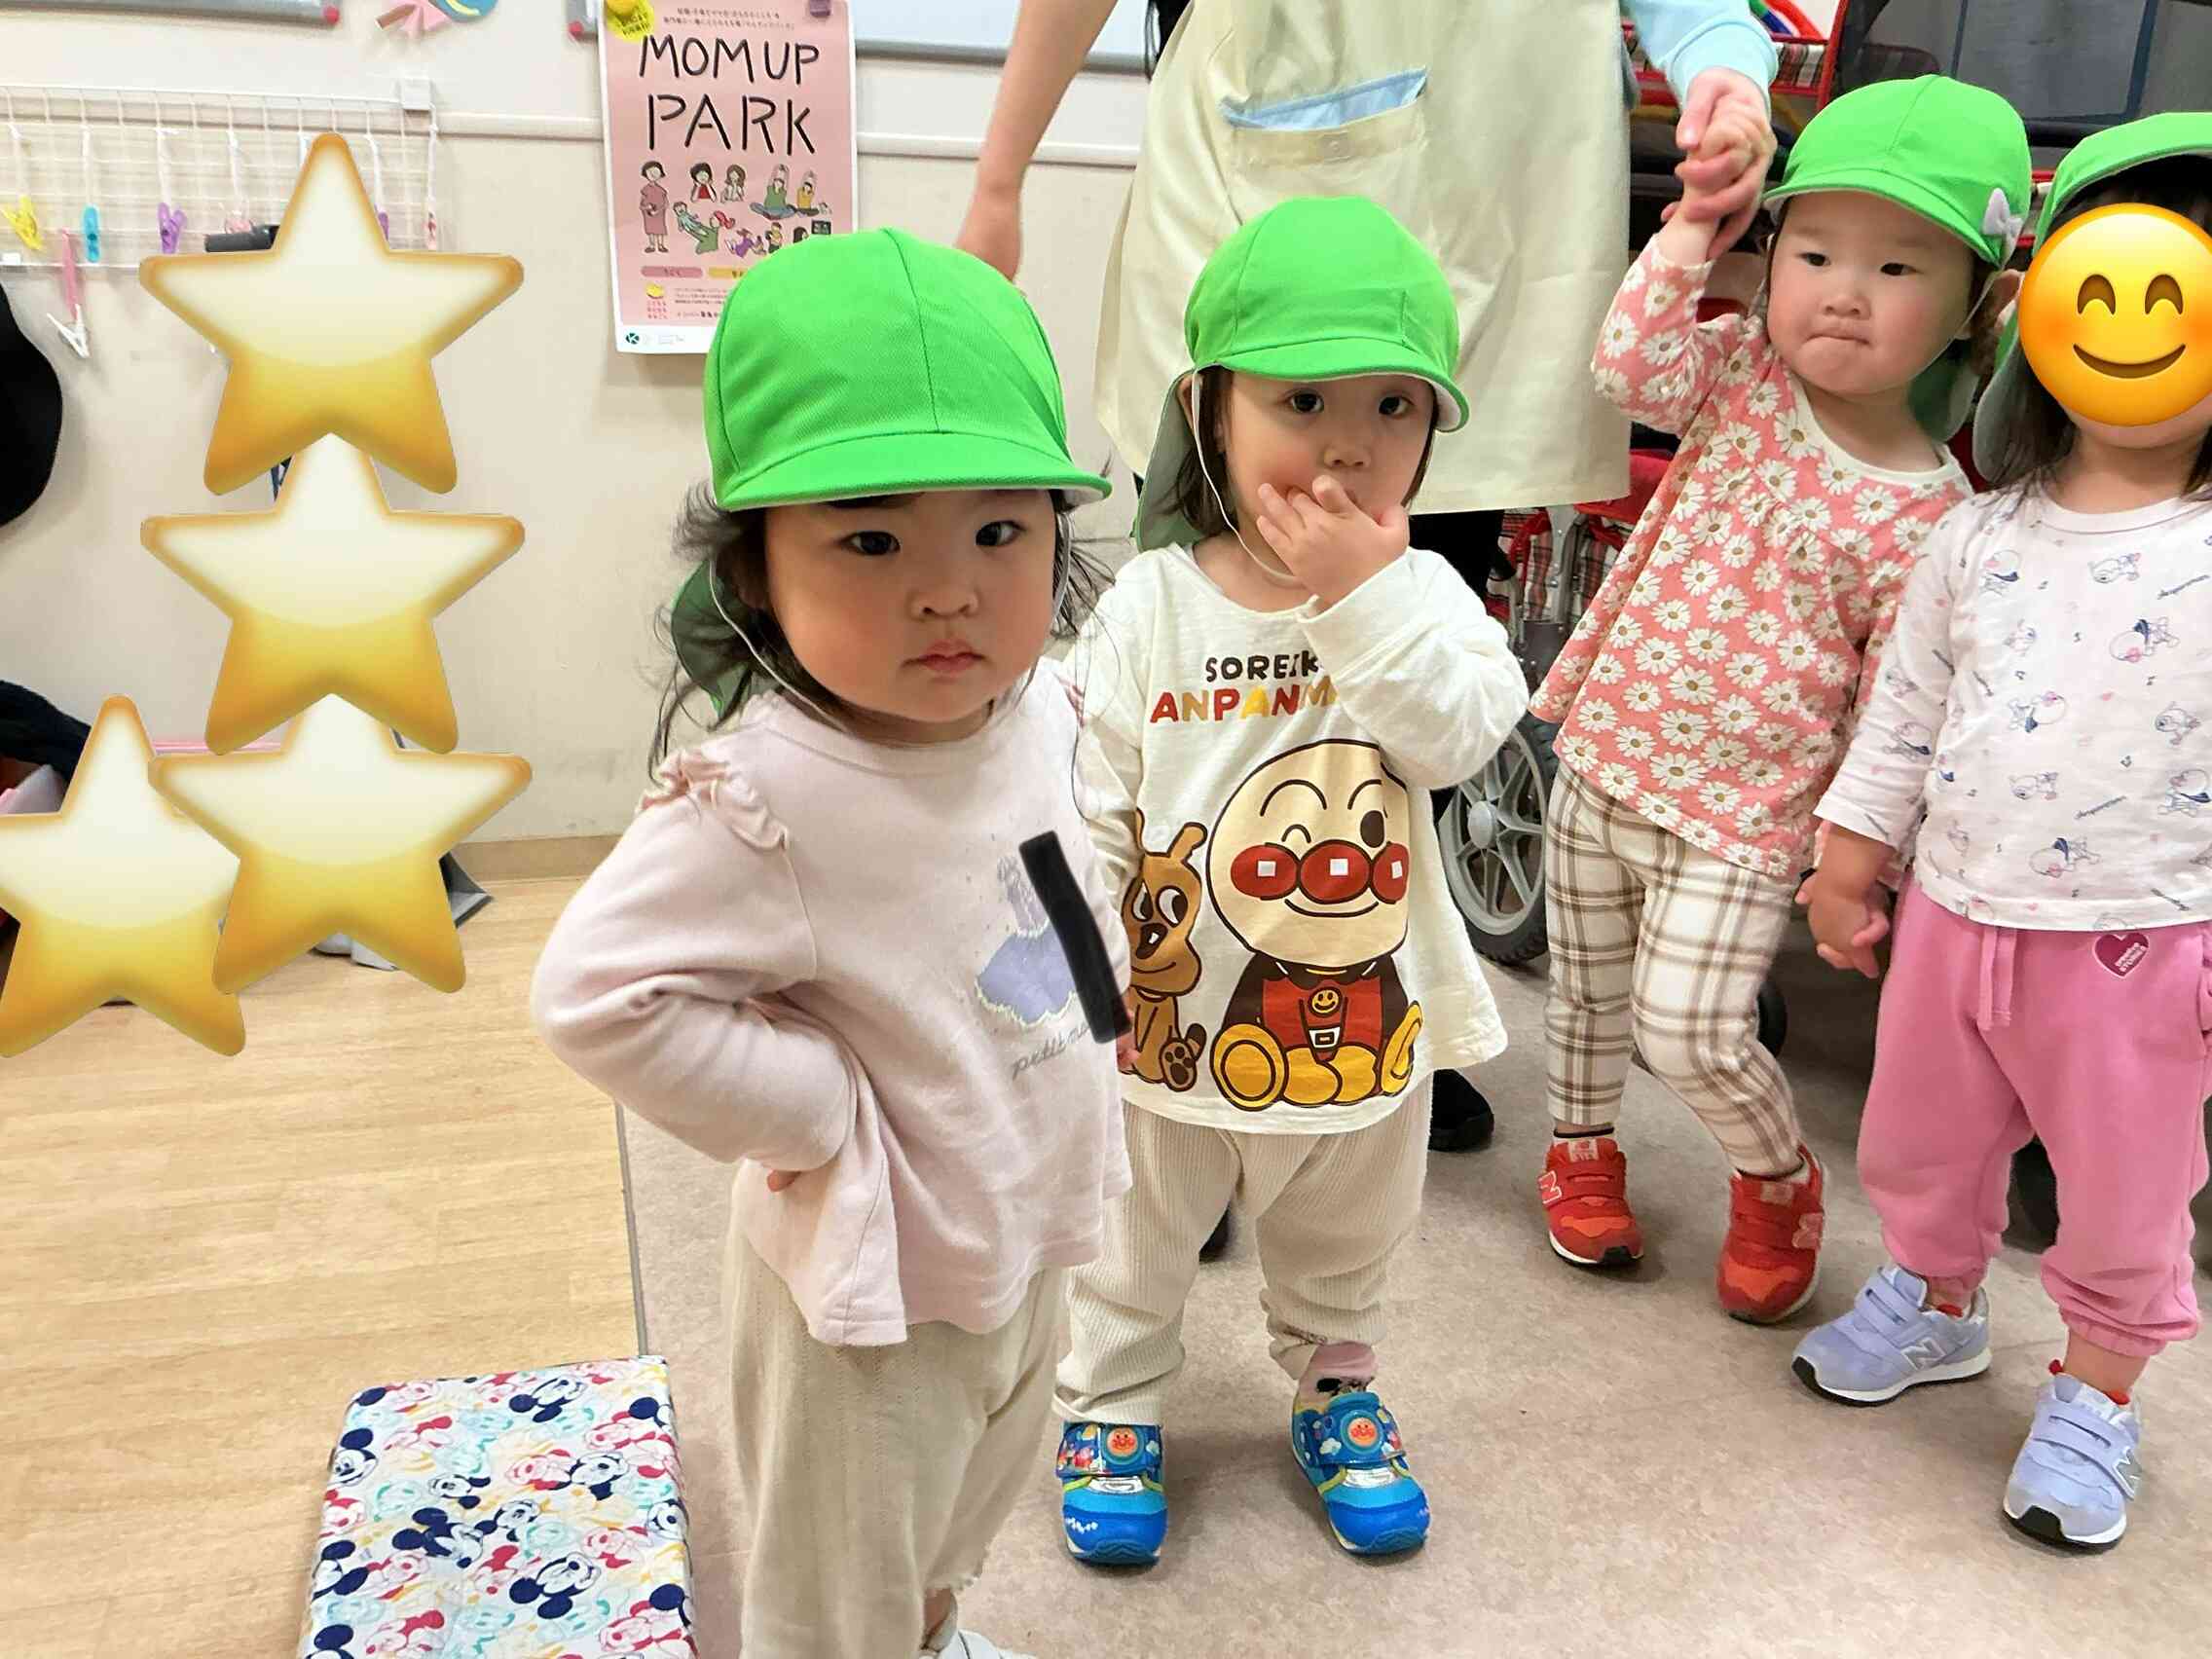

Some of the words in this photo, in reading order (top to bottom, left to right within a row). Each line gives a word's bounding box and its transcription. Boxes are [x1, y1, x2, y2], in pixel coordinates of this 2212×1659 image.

[647, 93, 816, 156] PARK
[1205, 650, 1320, 682] SOREIK
[1150, 675, 1340, 723] ANPANM
[1901, 1336, 1948, 1371] N
